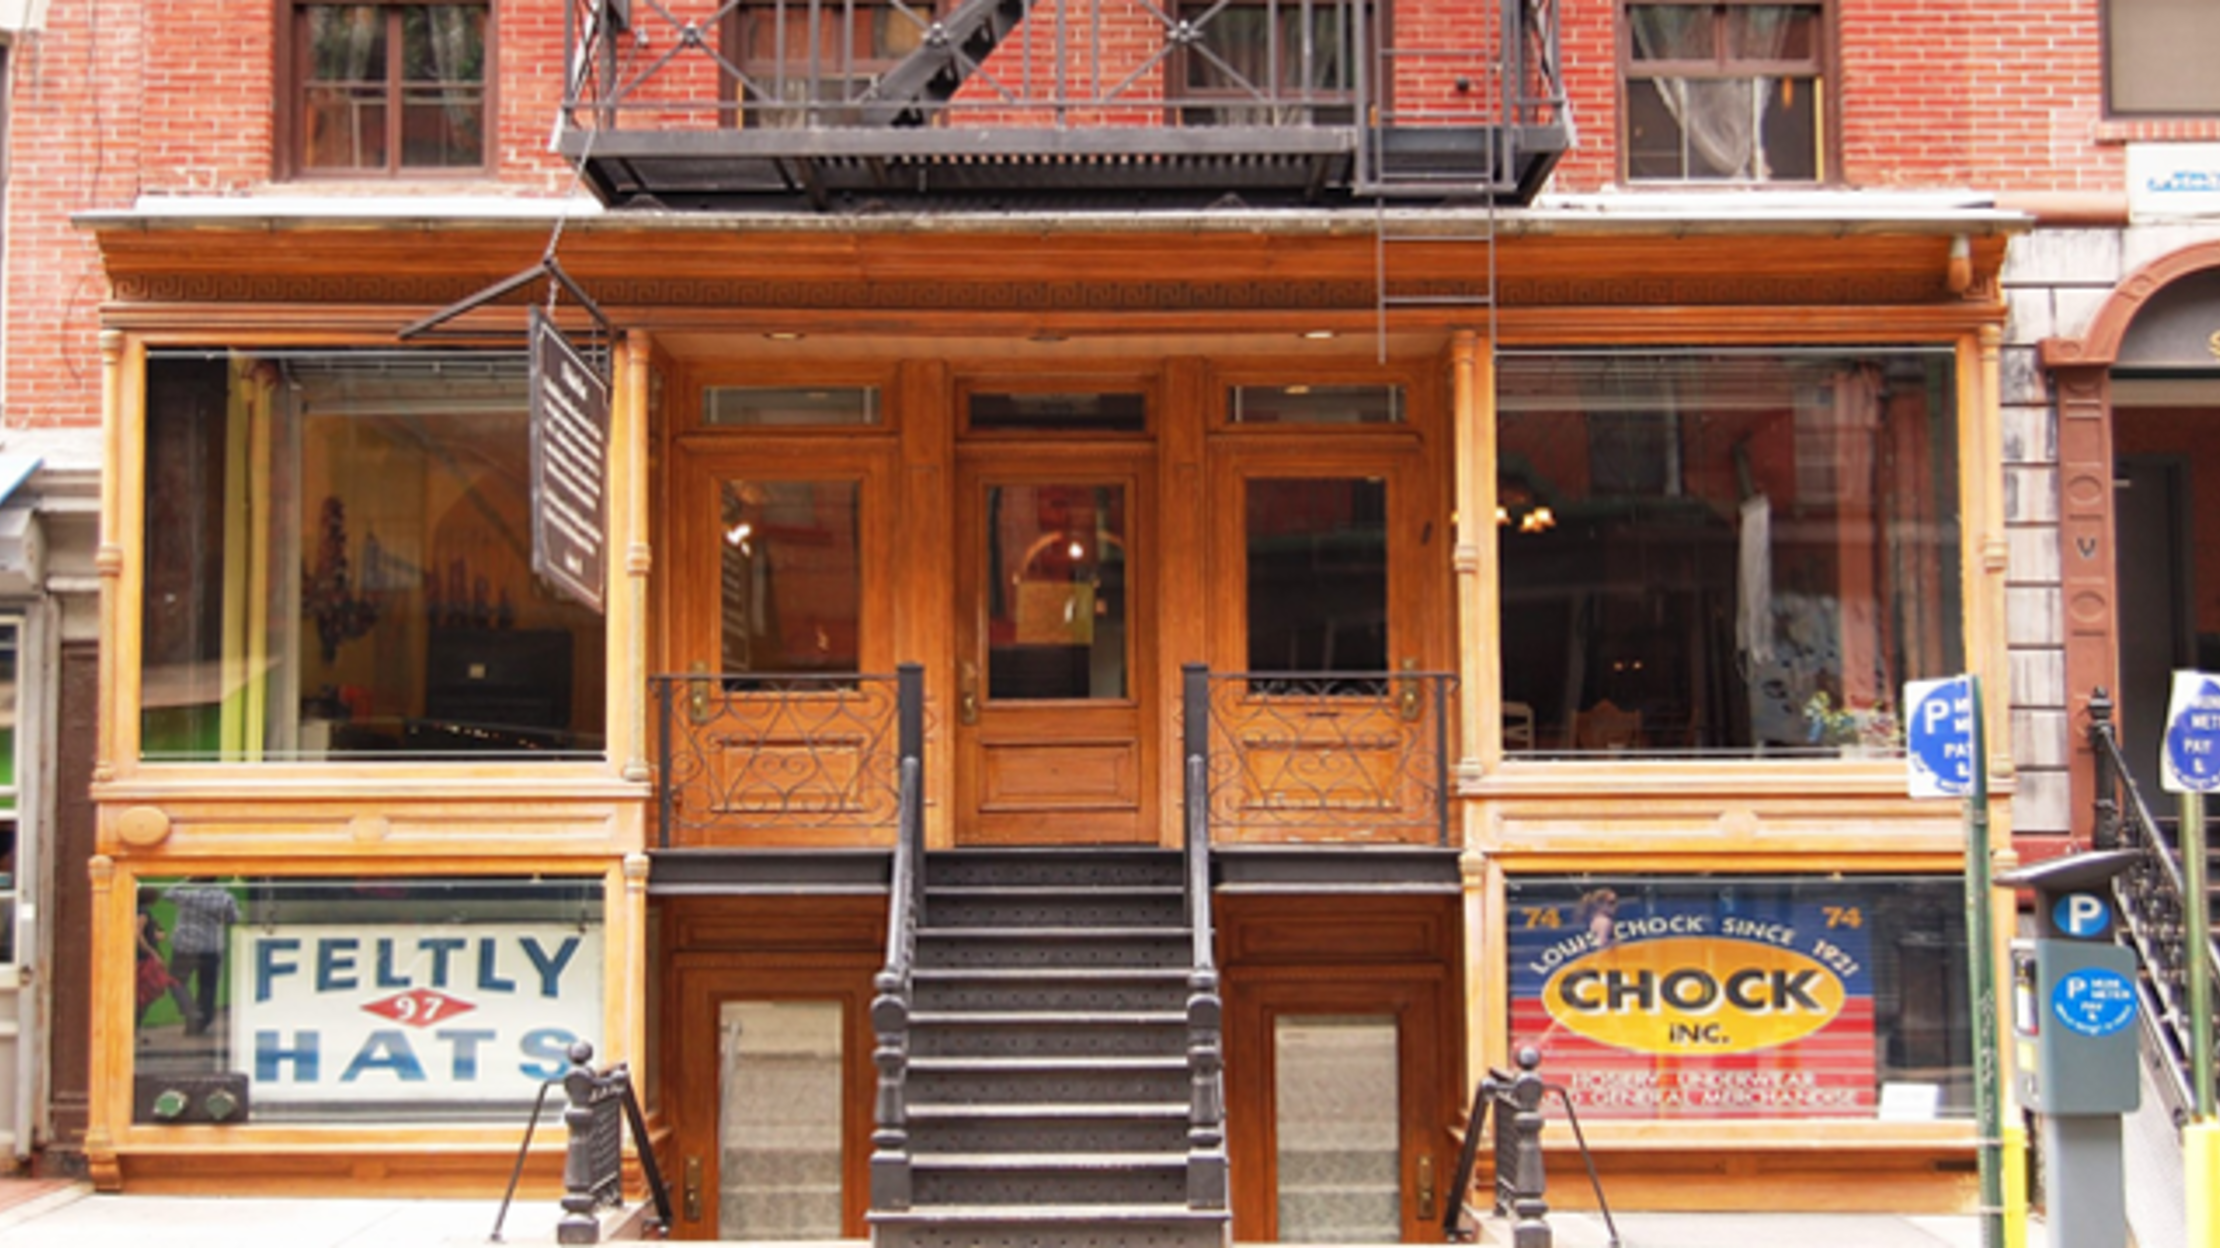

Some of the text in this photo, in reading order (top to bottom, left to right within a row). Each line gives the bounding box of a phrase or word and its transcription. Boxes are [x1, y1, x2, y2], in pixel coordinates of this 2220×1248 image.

[1924, 699, 1950, 734] P
[1521, 906, 1562, 930] 74
[1822, 906, 1863, 929] 74
[2069, 894, 2102, 935] P
[1529, 930, 1601, 975] LOUIS
[1613, 915, 1703, 941] CHOCK
[1721, 916, 1796, 946] SINCE
[254, 936, 582, 1004] FELTLY
[2067, 977, 2087, 999] P
[393, 997, 446, 1022] 97
[1559, 968, 1827, 1015] CHOCK
[254, 1028, 577, 1083] HATS
